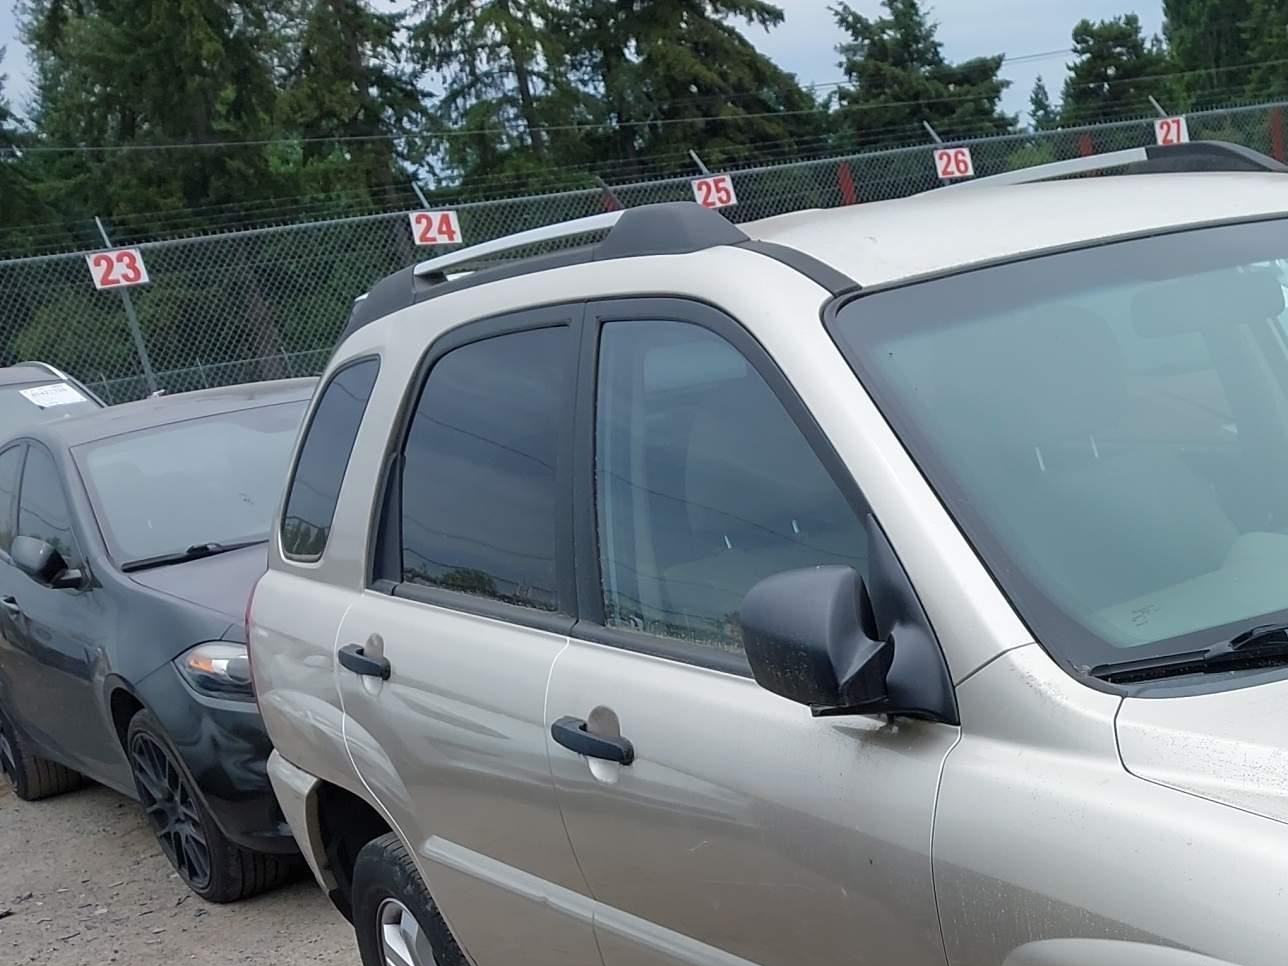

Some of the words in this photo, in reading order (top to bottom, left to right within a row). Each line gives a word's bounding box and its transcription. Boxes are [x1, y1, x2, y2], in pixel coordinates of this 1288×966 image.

[1160, 118, 1182, 144] 27
[938, 149, 969, 175] 26
[696, 177, 731, 207] 25
[415, 213, 456, 243] 24
[93, 251, 142, 286] 23
